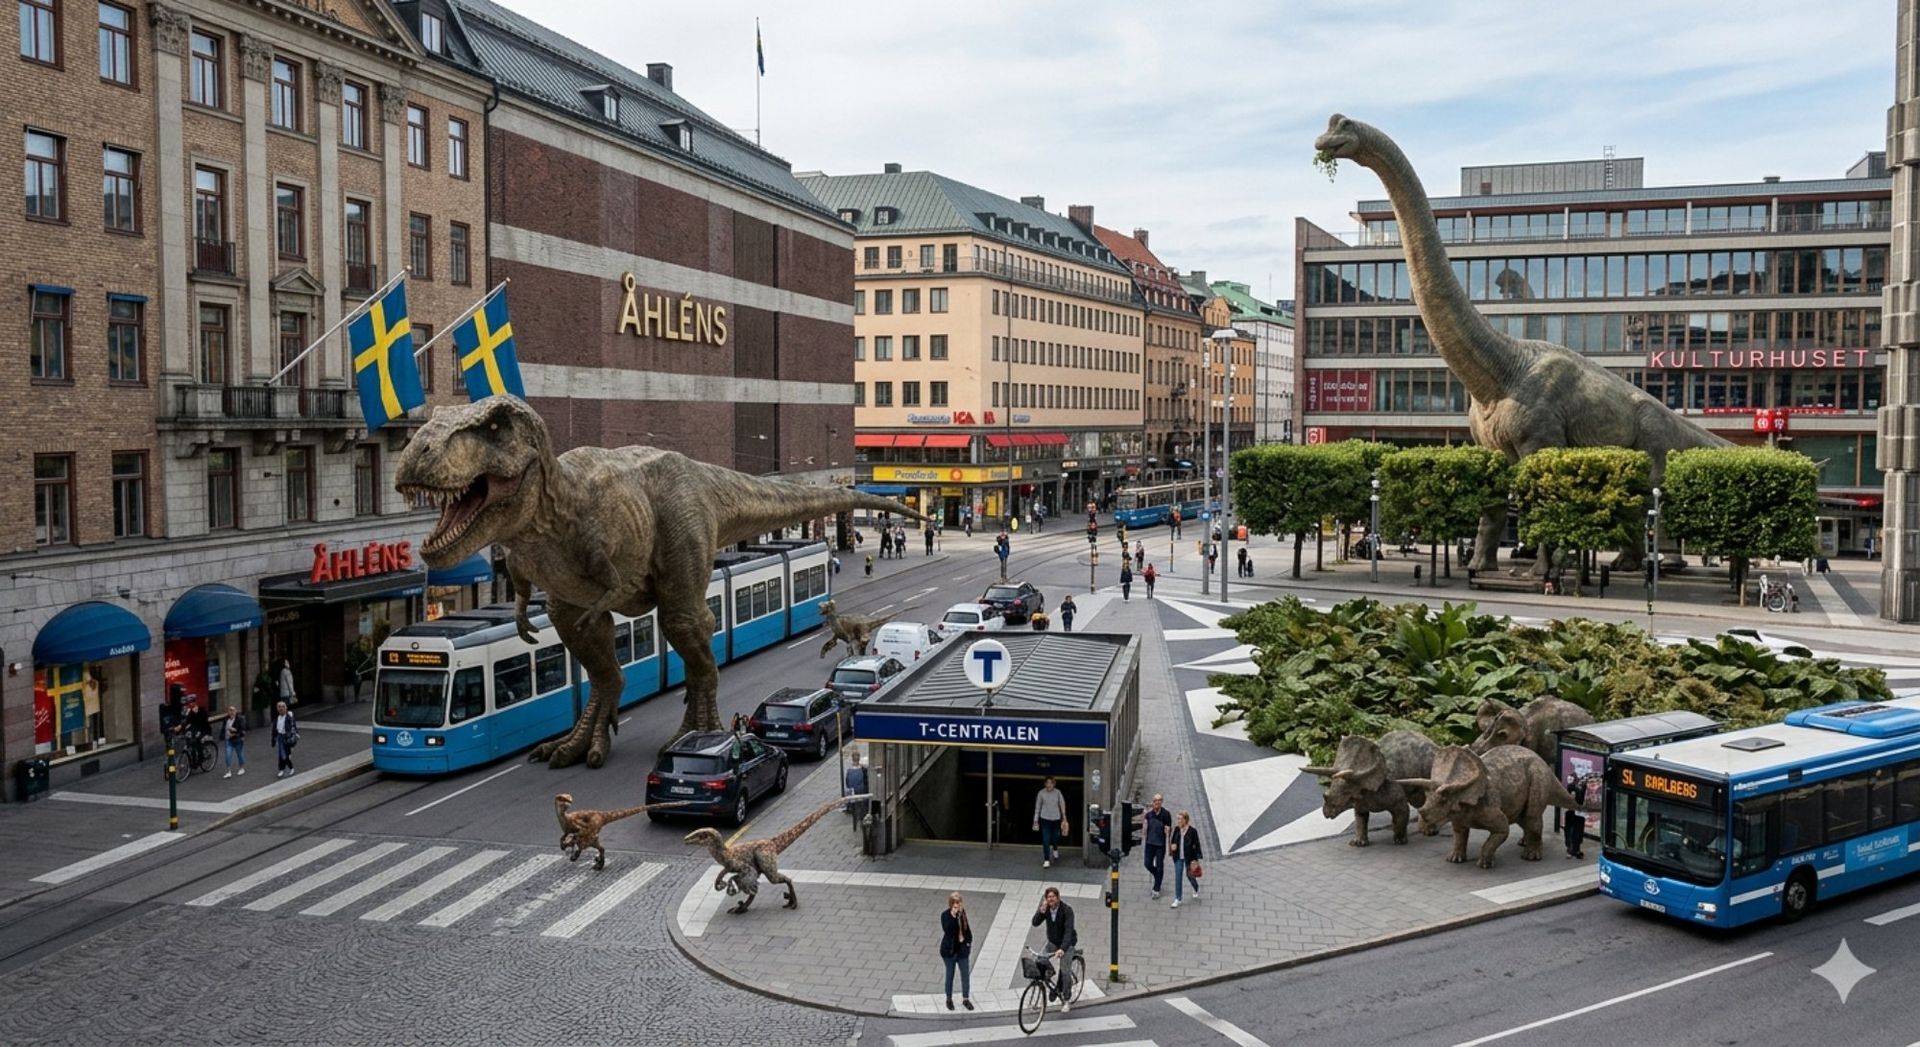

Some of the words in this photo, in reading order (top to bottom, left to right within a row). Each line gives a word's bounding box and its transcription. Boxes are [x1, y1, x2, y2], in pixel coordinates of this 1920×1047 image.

[618, 271, 727, 346] ÅHLÉNS
[1651, 350, 1868, 368] KULTURHUSET
[953, 411, 976, 425] ICA
[973, 650, 1002, 683] T
[919, 722, 1039, 741] T-CENTRALEN
[1622, 768, 1636, 785] SL
